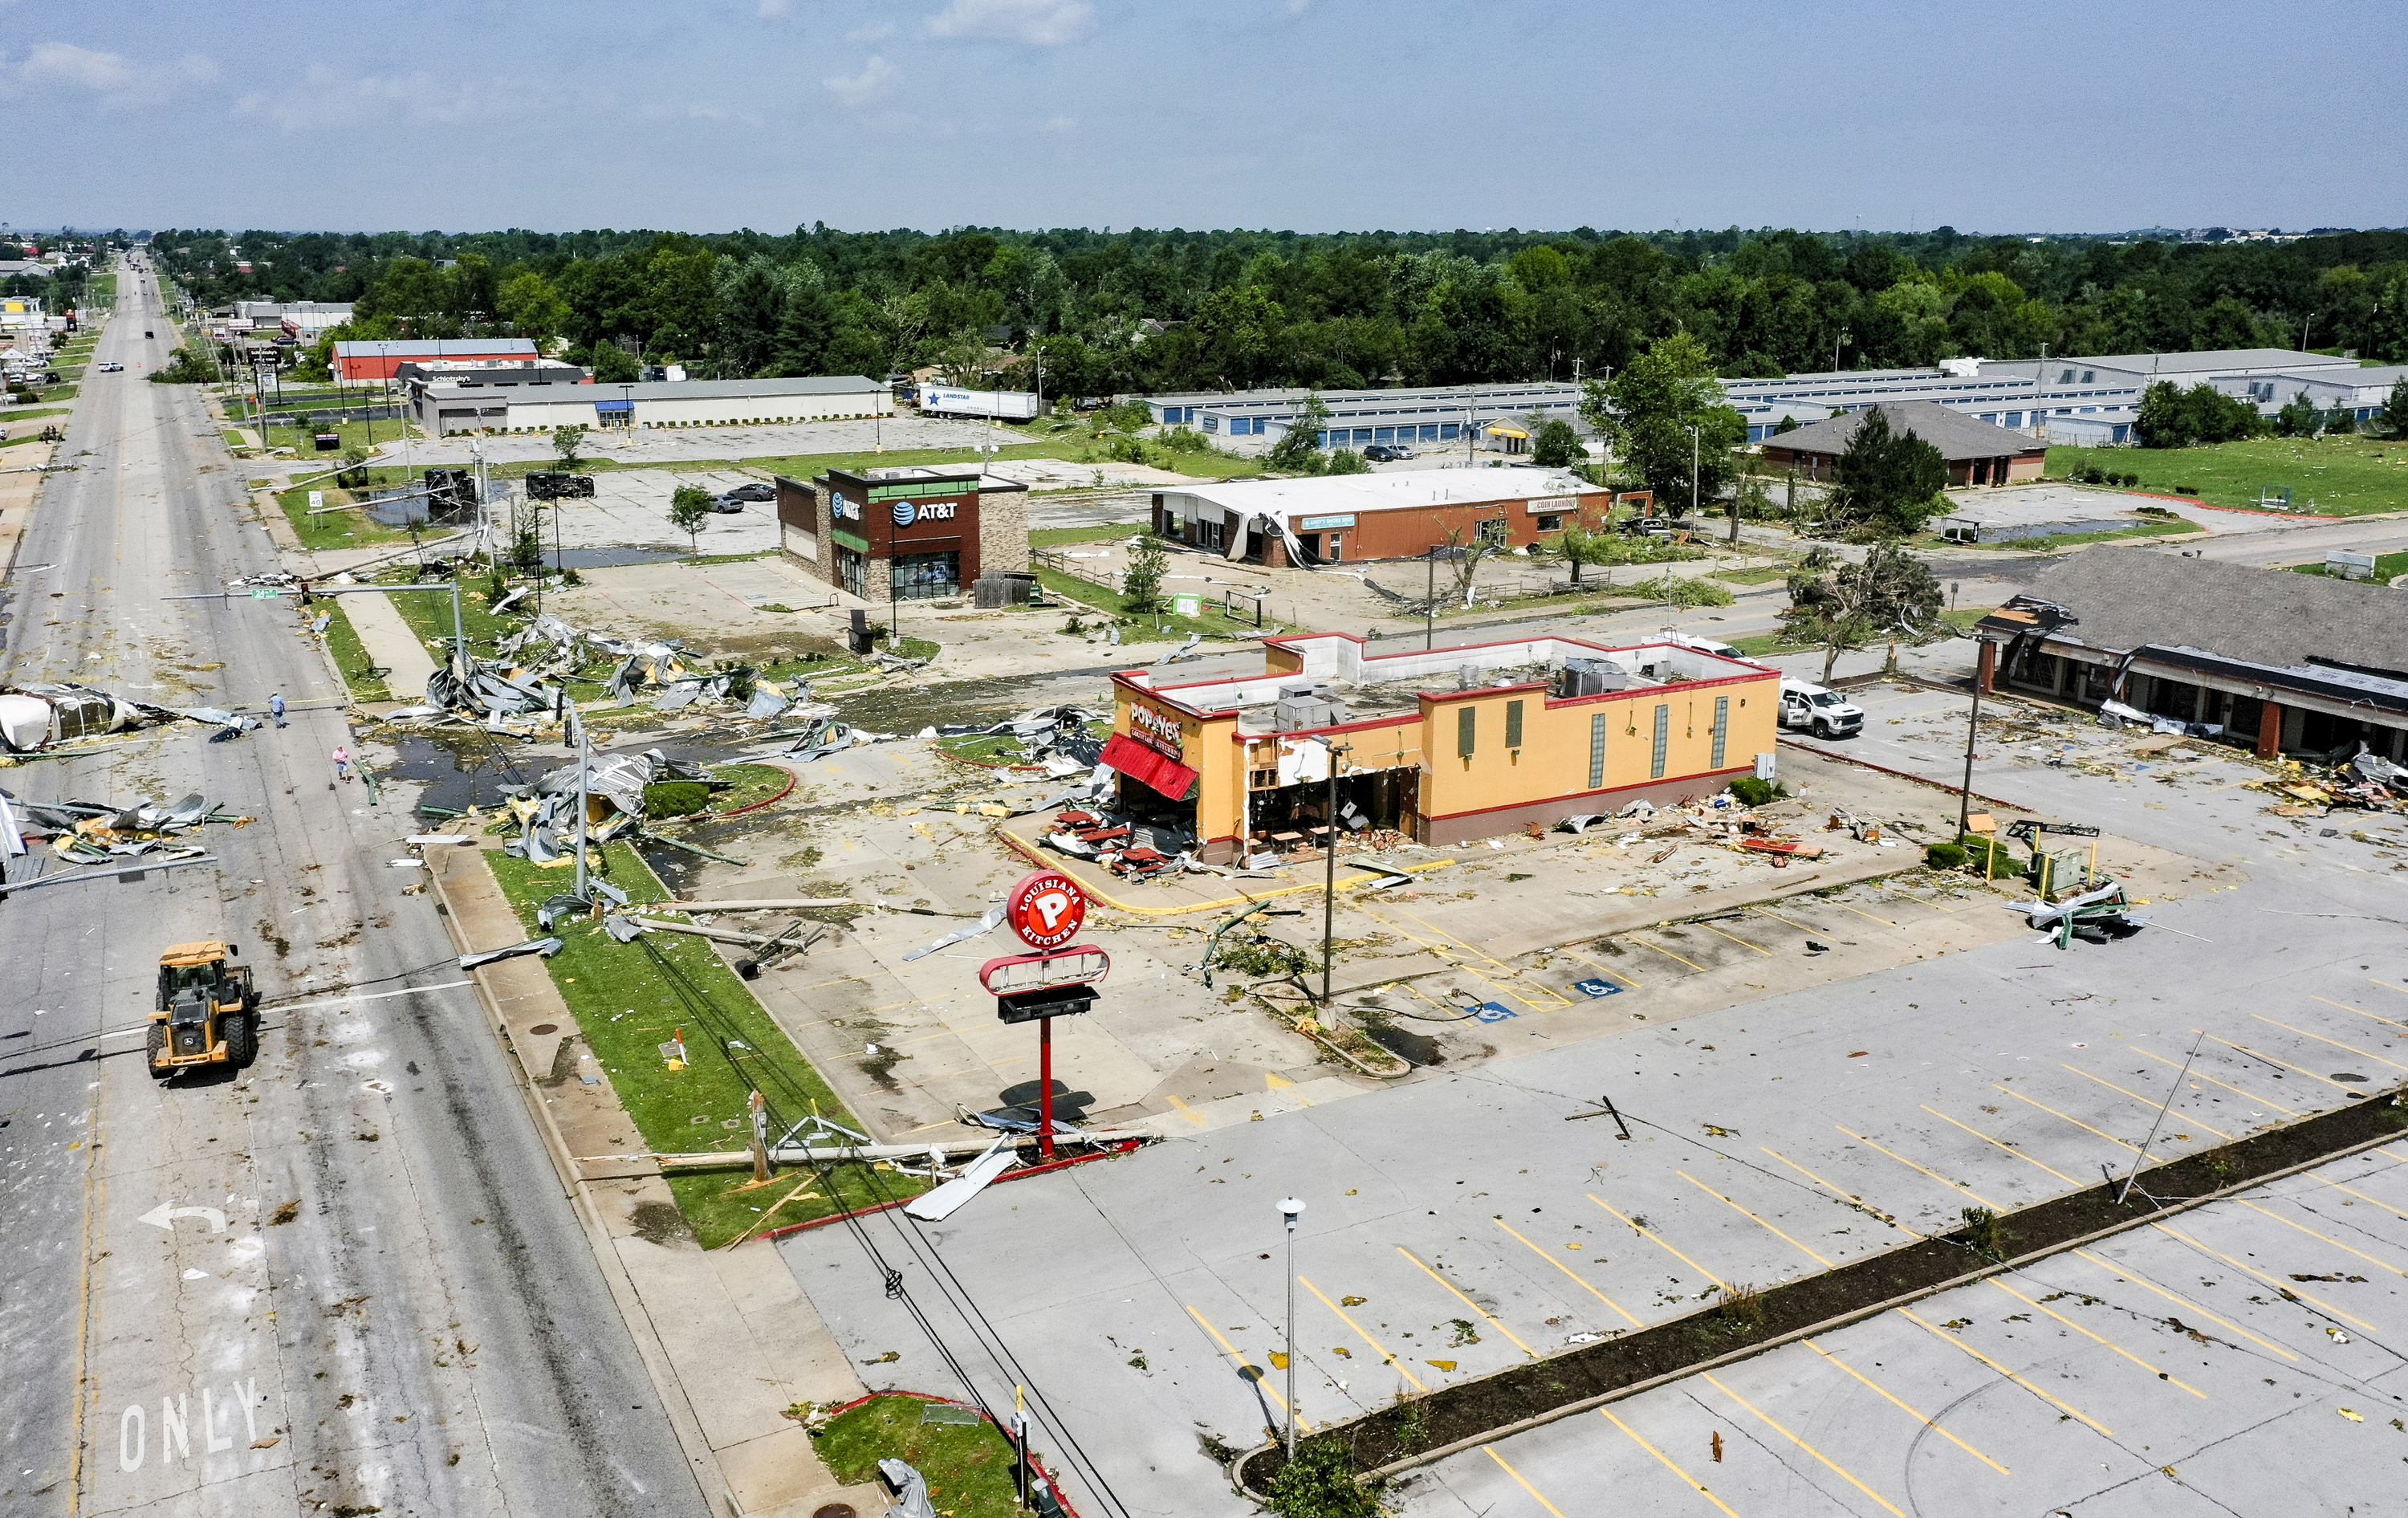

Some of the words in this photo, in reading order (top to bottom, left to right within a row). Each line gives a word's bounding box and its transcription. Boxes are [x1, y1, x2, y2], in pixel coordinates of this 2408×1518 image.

[842, 499, 860, 521] AT&T
[917, 503, 958, 520] AT&T
[1537, 500, 1550, 508] COIN
[1131, 729, 1153, 745] LOUISIAN
[1156, 740, 1178, 757] KITCHEN
[1019, 879, 1080, 912] LOUISIANA
[1035, 893, 1068, 930] P
[1022, 919, 1077, 945] KITCHEN
[120, 1377, 257, 1472] ONLY
